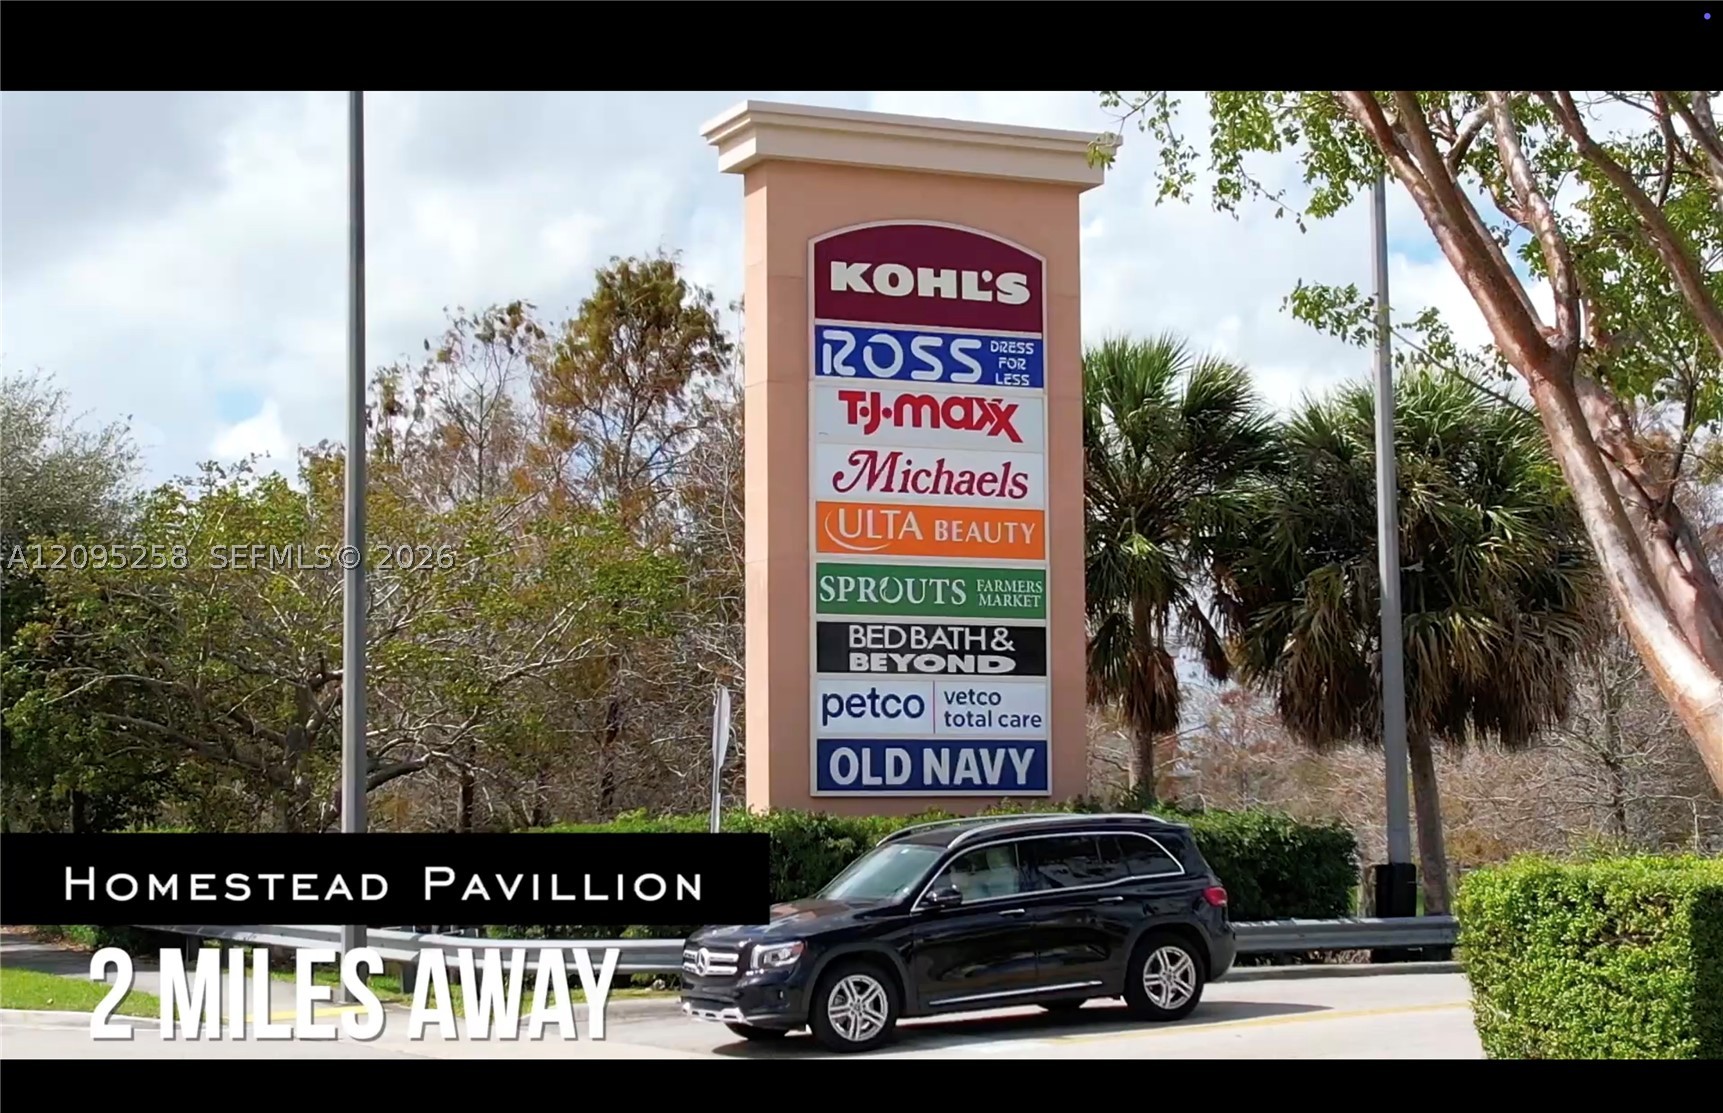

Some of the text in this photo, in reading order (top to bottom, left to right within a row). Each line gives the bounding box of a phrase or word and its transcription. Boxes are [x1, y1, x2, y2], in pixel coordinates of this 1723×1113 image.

[831, 261, 1030, 305] KOHL'S
[822, 329, 982, 383] ROSS
[990, 340, 1034, 355] DRESS
[998, 357, 1026, 370] FOR
[995, 373, 1029, 386] LESS
[832, 449, 1028, 499] Michaels
[837, 508, 1035, 544] ULTA BEAUTY
[819, 575, 967, 605] SPROUTS
[976, 579, 1042, 594] FARMERS
[978, 594, 1041, 608] MARKET
[850, 625, 1016, 651] BED BATH &
[850, 653, 1016, 674] BEYOND
[821, 687, 925, 726] petco
[944, 688, 1002, 706] vetco
[944, 710, 1042, 728] total care
[829, 747, 1035, 786] OLD NAVY
